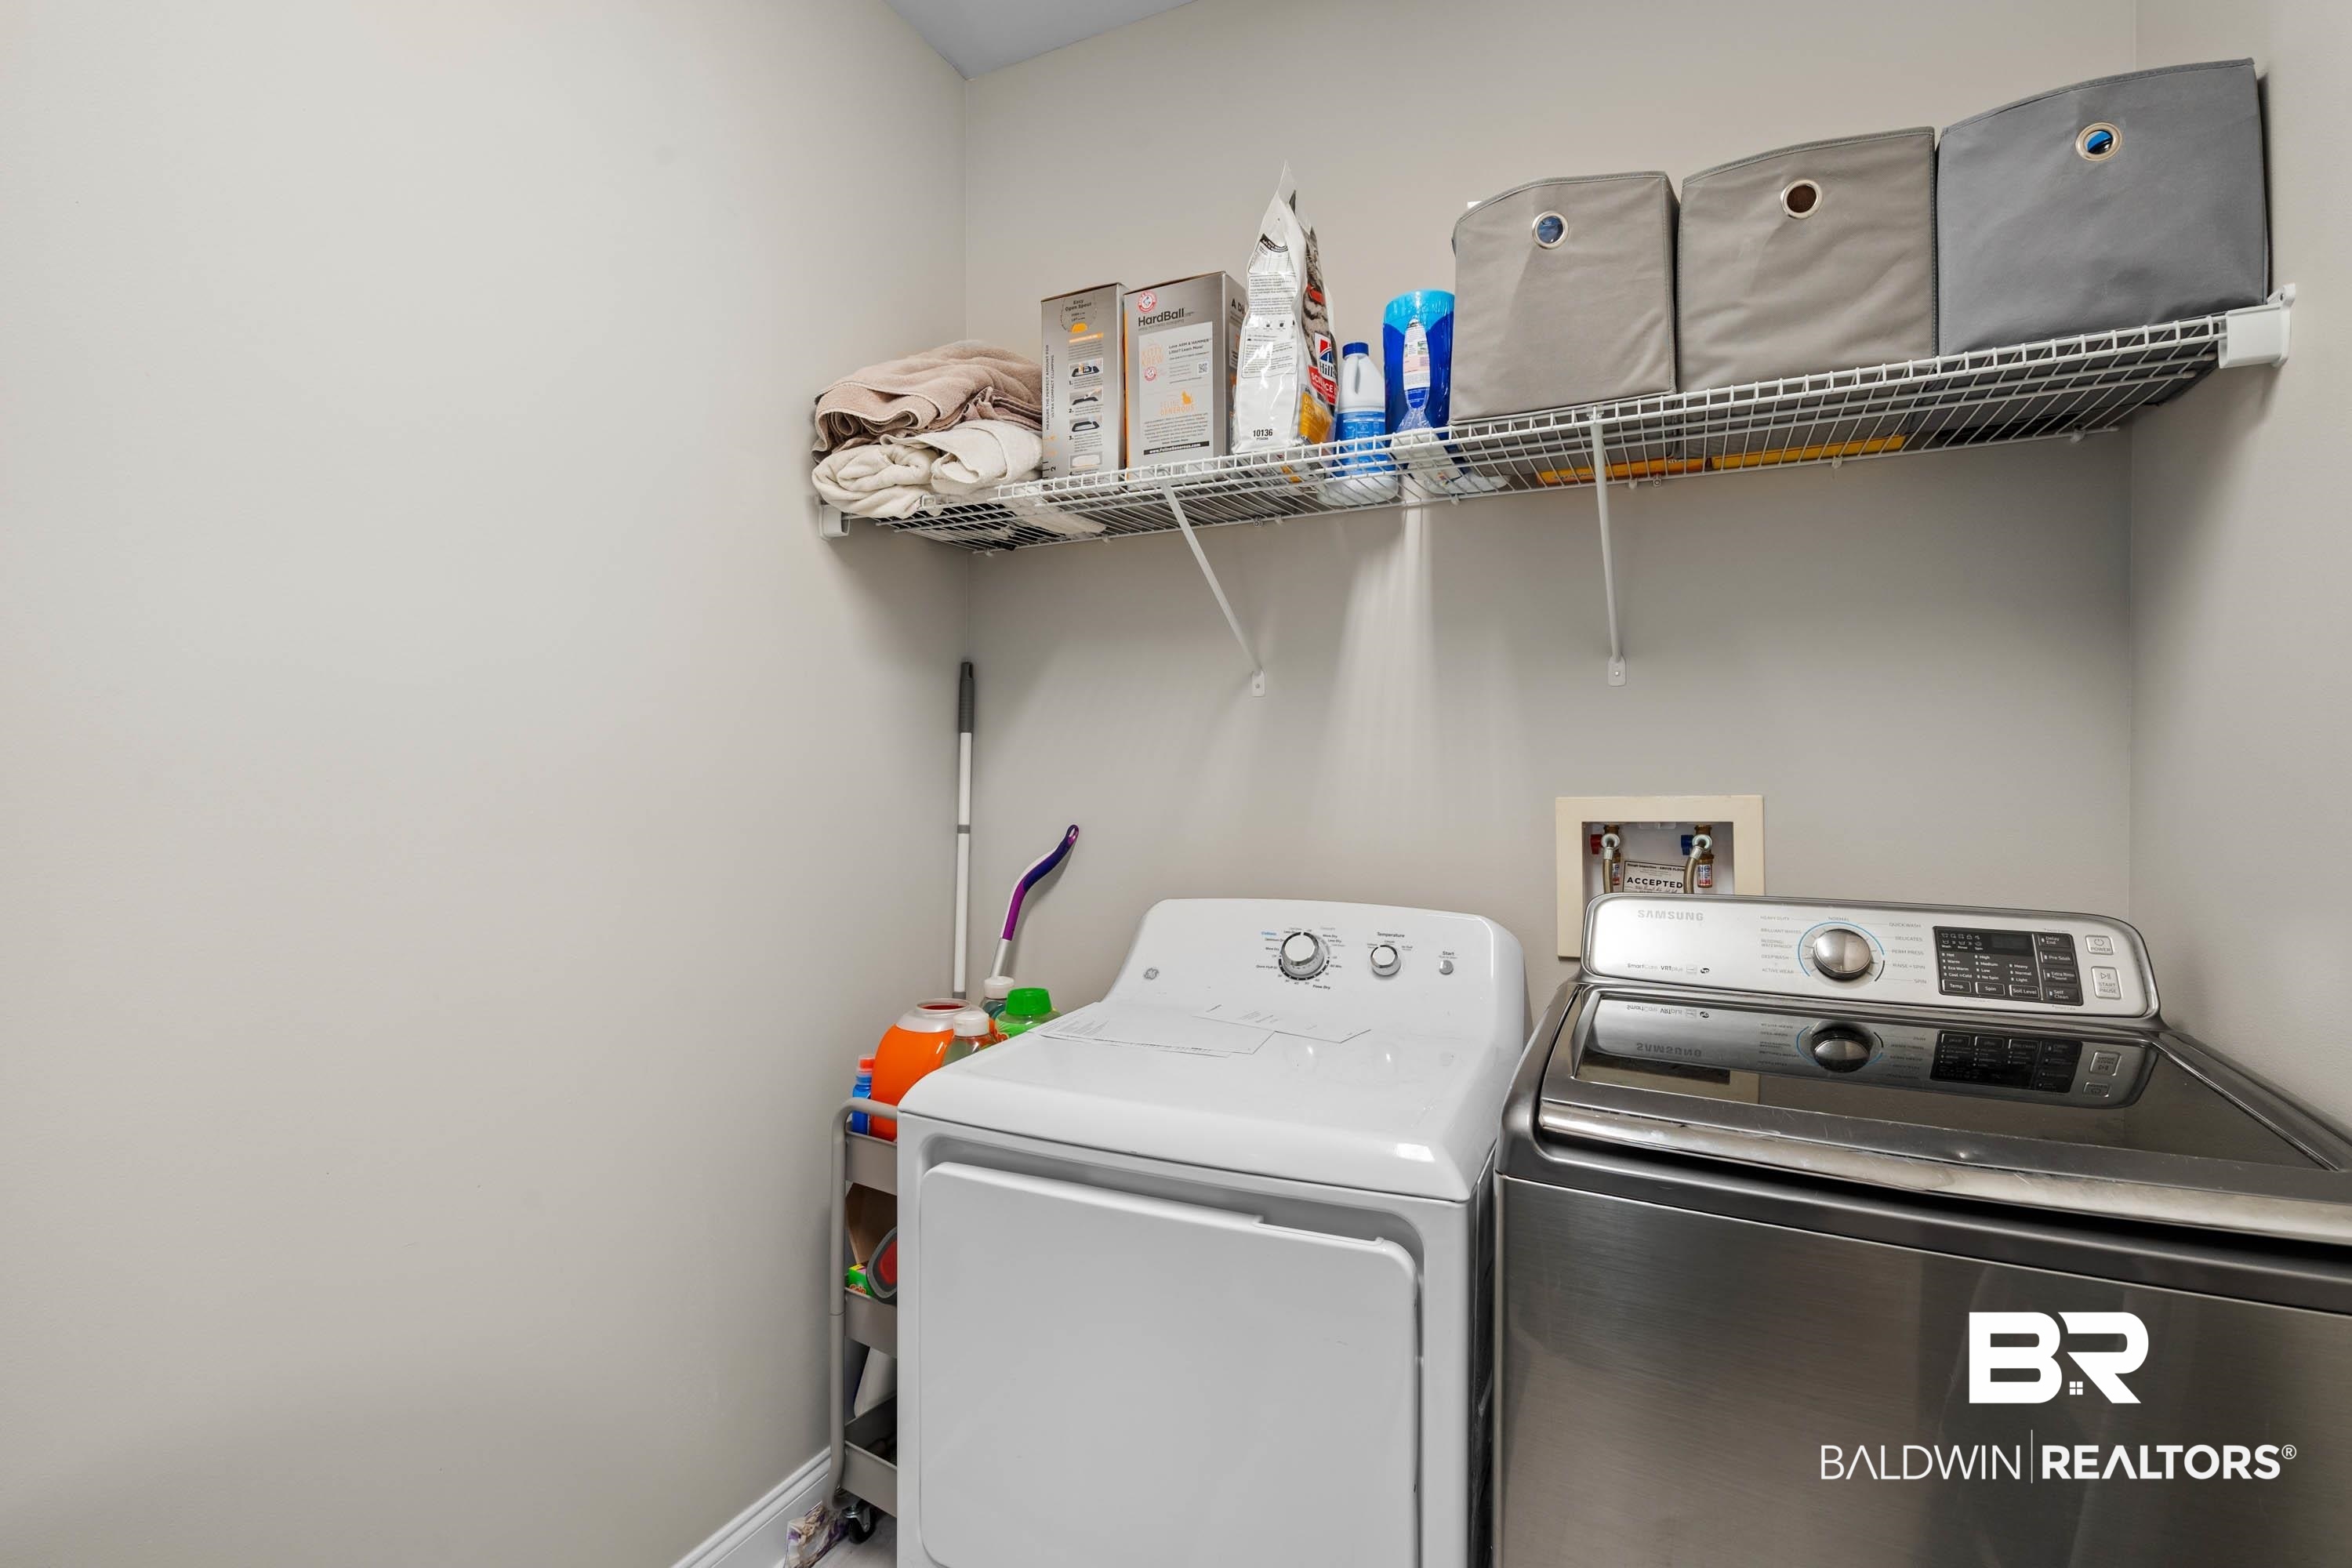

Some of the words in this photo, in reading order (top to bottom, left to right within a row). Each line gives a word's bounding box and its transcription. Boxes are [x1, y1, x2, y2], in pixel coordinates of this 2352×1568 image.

[1138, 307, 1185, 327] HardBall
[1253, 429, 1273, 437] 10136
[1627, 877, 1683, 888] ACCEPTED
[1638, 909, 1704, 922] SAMSUNG
